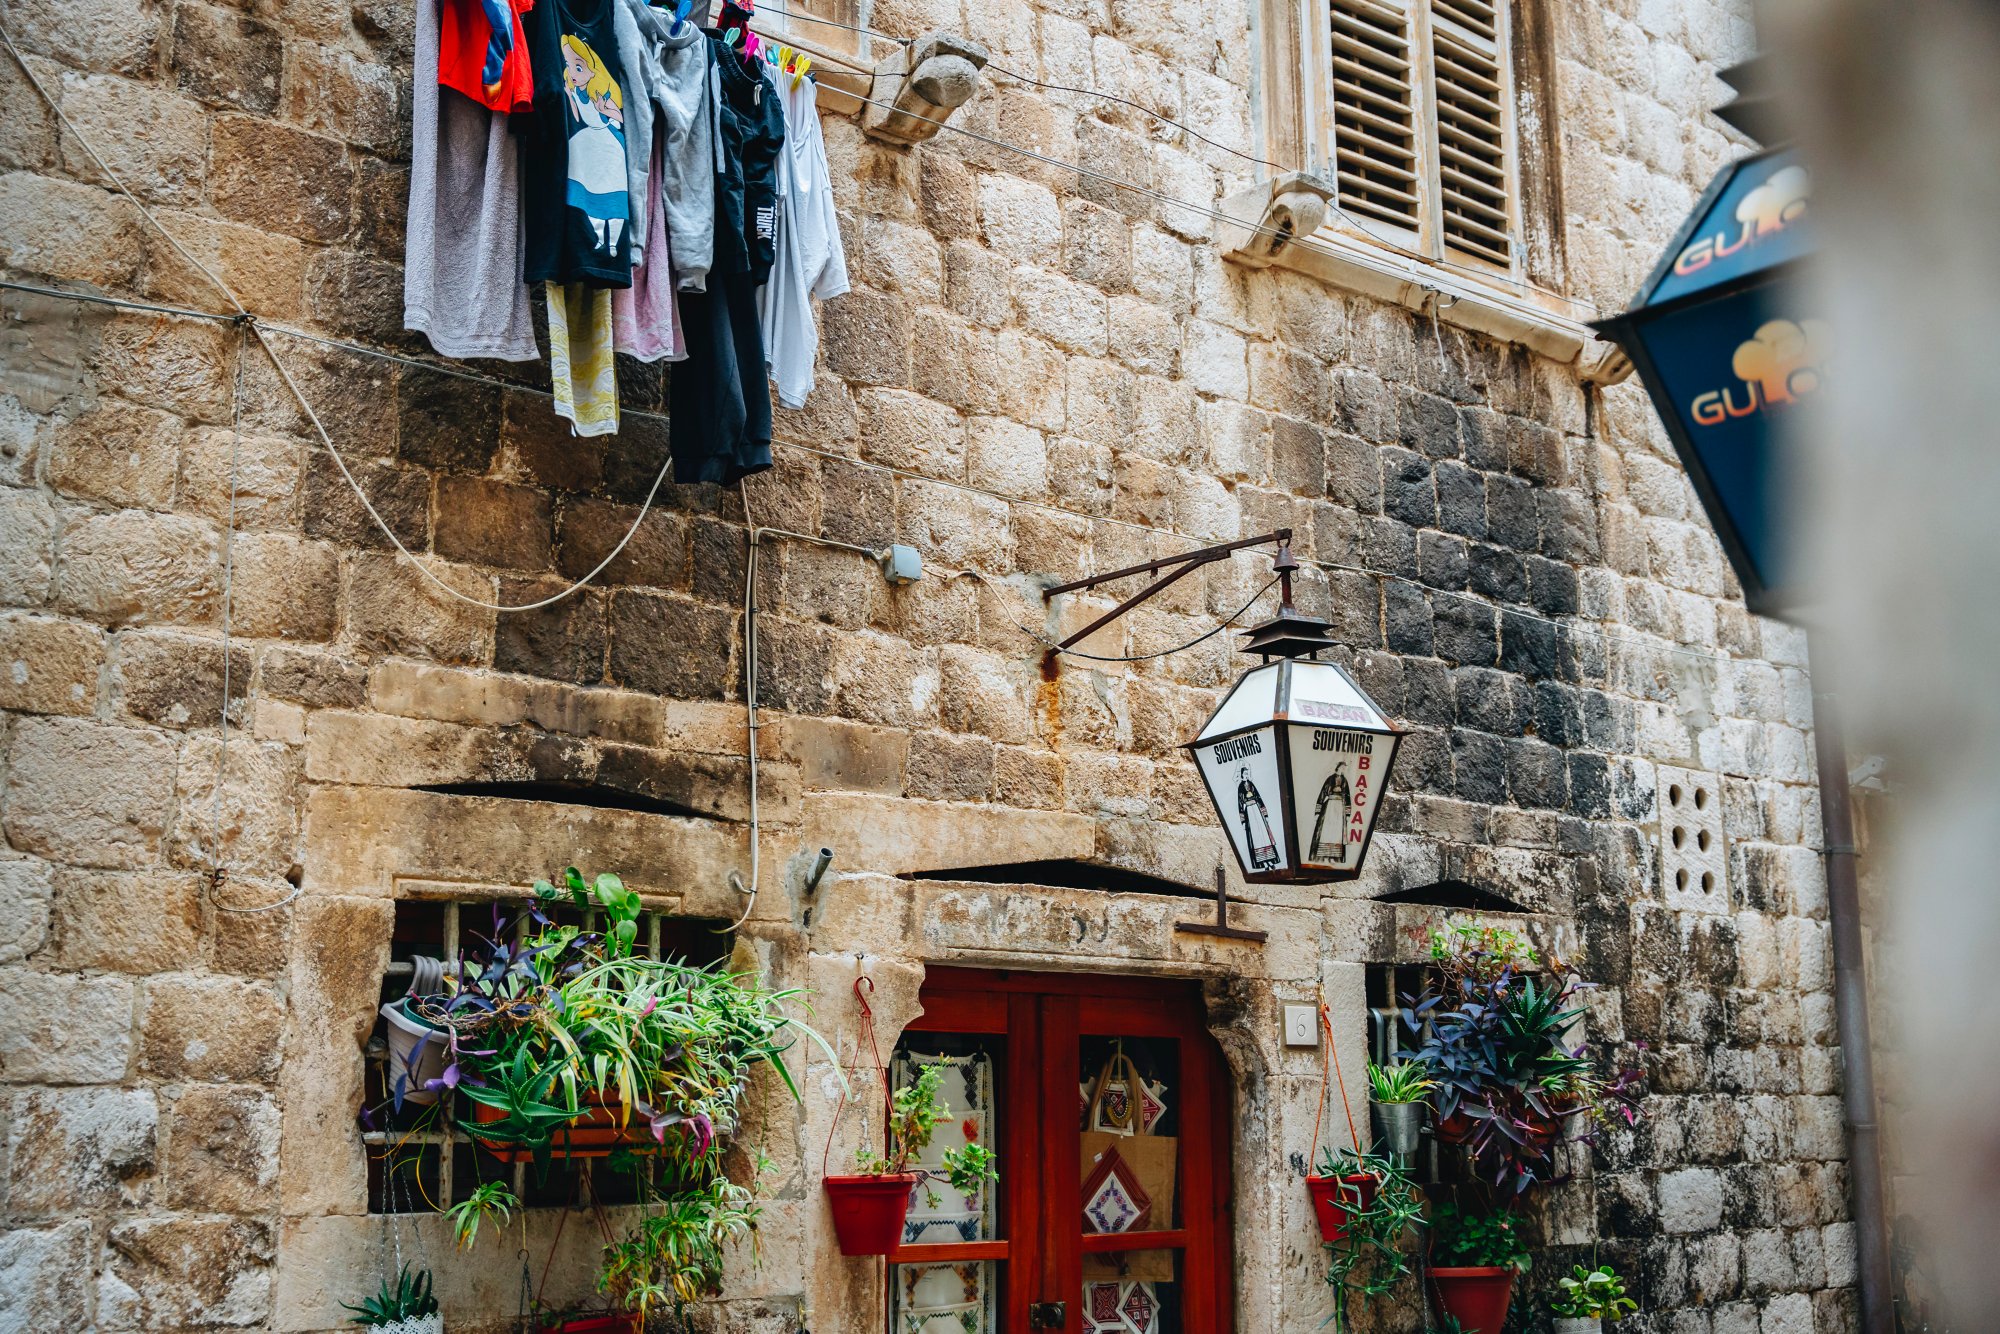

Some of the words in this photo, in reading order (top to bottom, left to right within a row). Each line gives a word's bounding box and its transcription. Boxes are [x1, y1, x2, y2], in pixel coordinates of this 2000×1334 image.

[756, 206, 775, 240] TRUCK
[1302, 703, 1366, 722] BAČAN
[1213, 733, 1262, 765] SOUVENIRS
[1312, 729, 1374, 755] SOUVENIRS
[1349, 756, 1371, 843] BAČAN
[1296, 1013, 1307, 1038] 6
